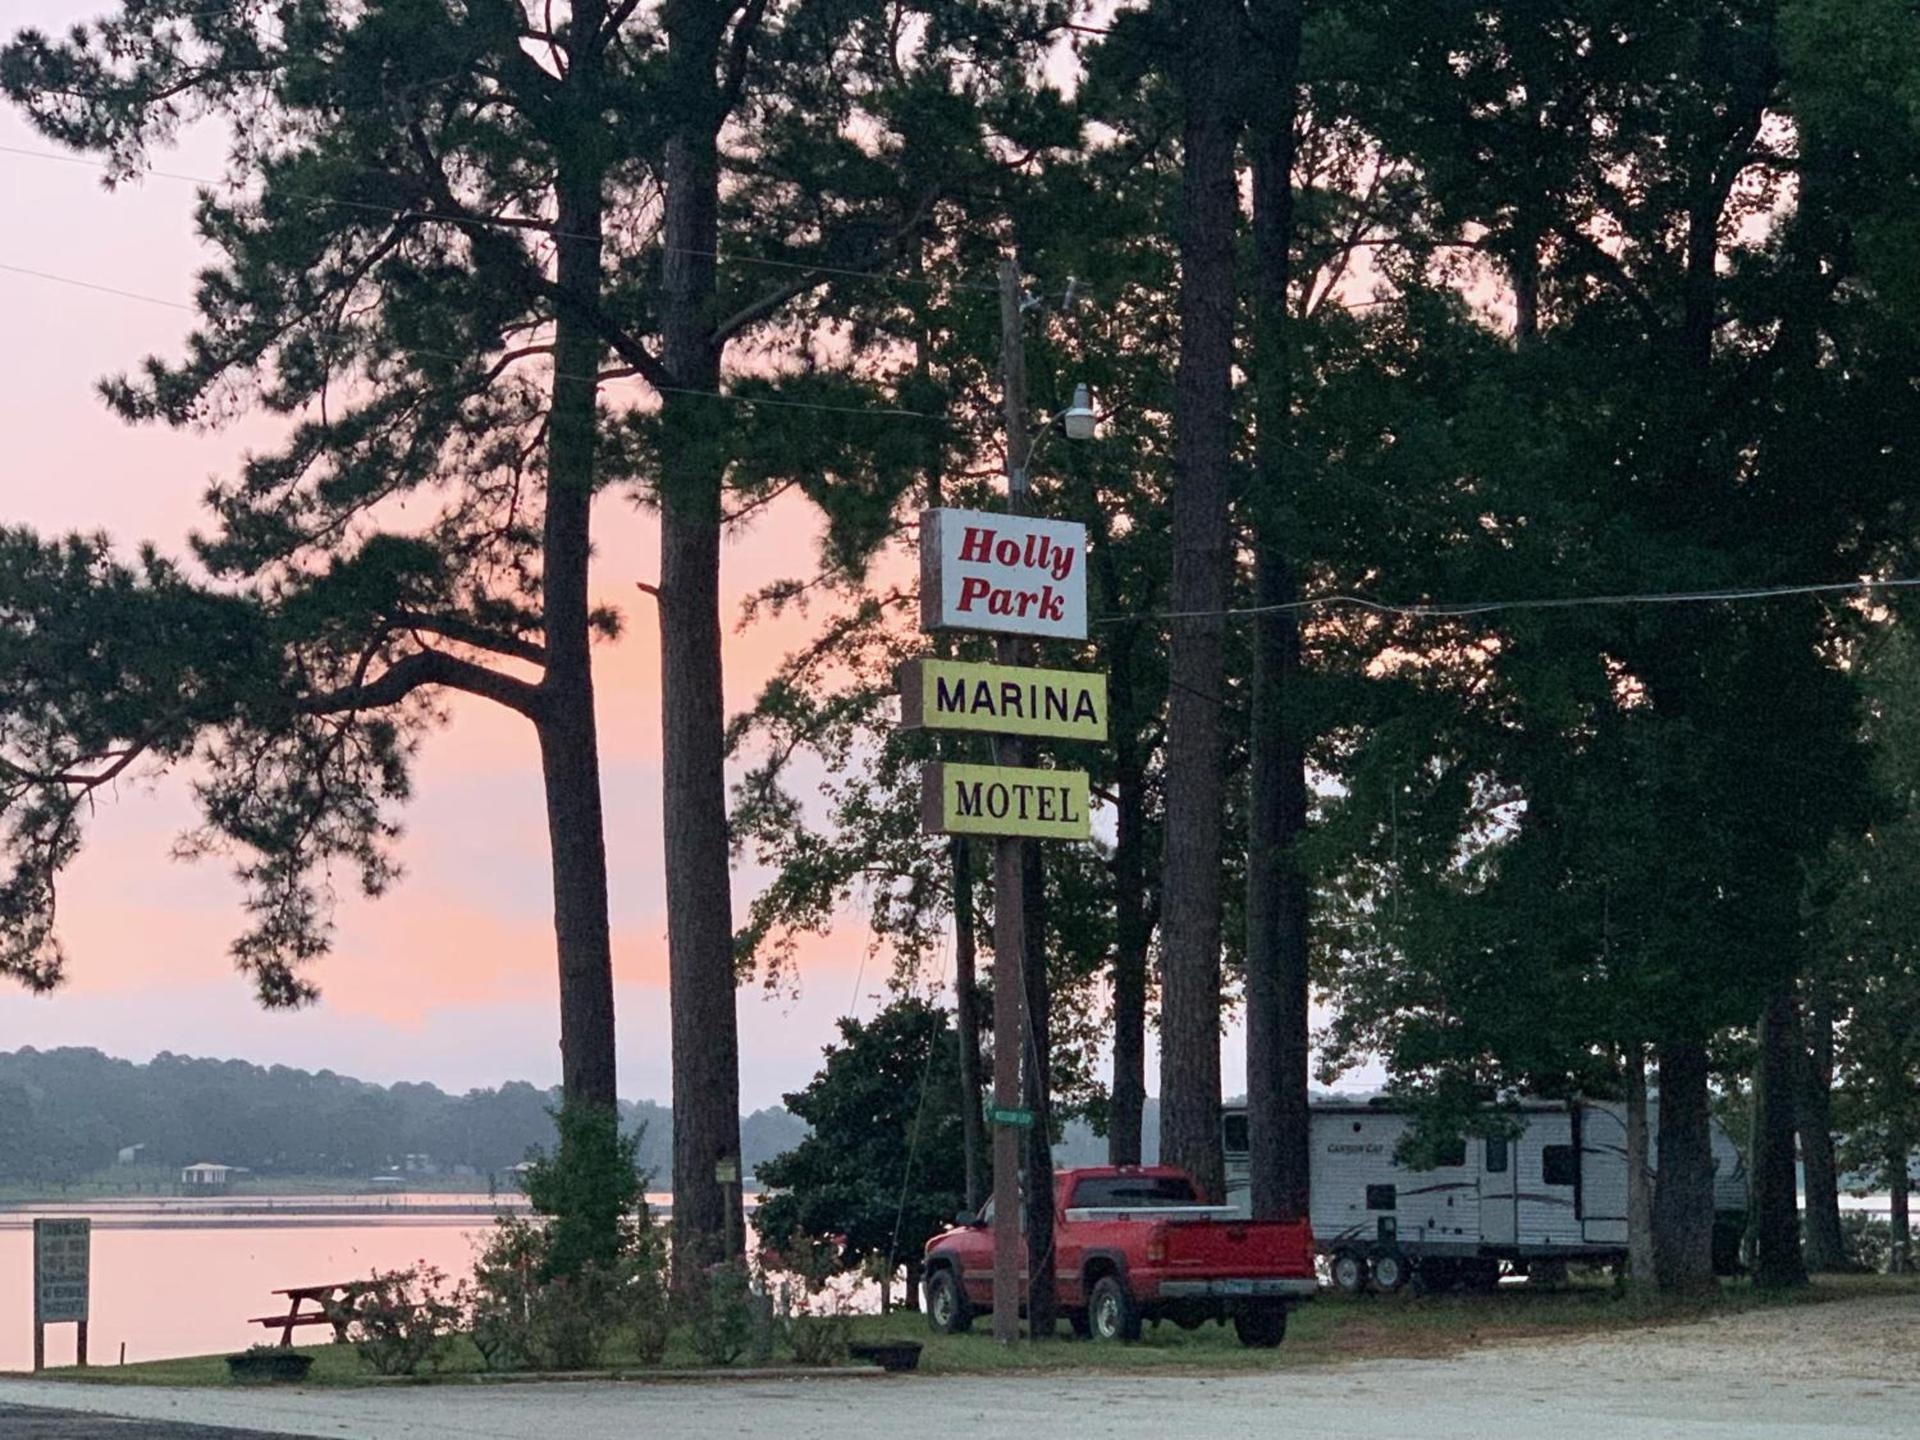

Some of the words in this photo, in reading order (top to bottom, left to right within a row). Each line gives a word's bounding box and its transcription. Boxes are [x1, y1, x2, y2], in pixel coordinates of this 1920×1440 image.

[958, 527, 1075, 581] Holly
[956, 576, 1065, 621] Park
[937, 676, 1098, 725] MARINA
[955, 780, 1079, 823] MOTEL
